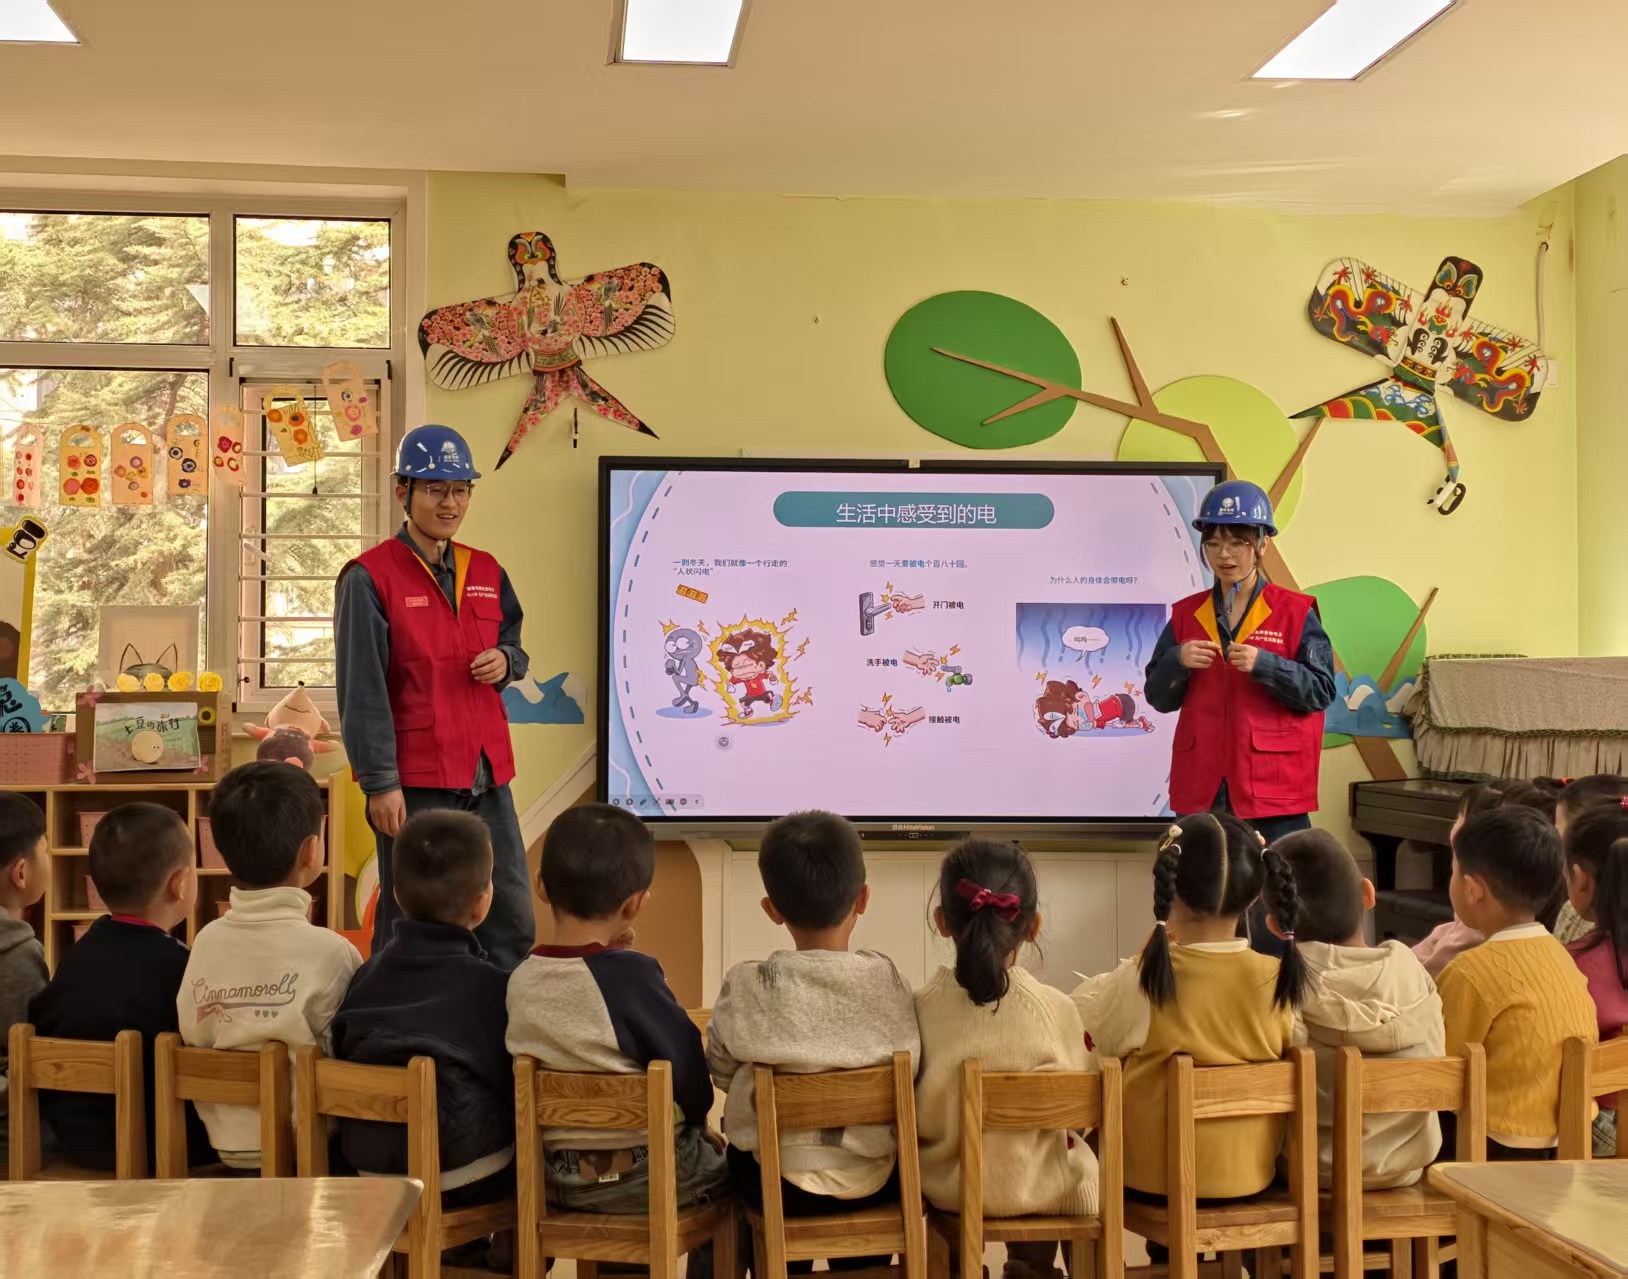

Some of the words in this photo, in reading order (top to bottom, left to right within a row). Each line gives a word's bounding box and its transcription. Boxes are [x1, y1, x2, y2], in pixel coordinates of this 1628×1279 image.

[836, 503, 997, 525] 生活中感受到的电
[932, 600, 965, 610] 开门被电
[866, 658, 898, 667] 洗手被电
[929, 716, 961, 724] 接触被电
[191, 972, 299, 1006] Cinnamoroll
